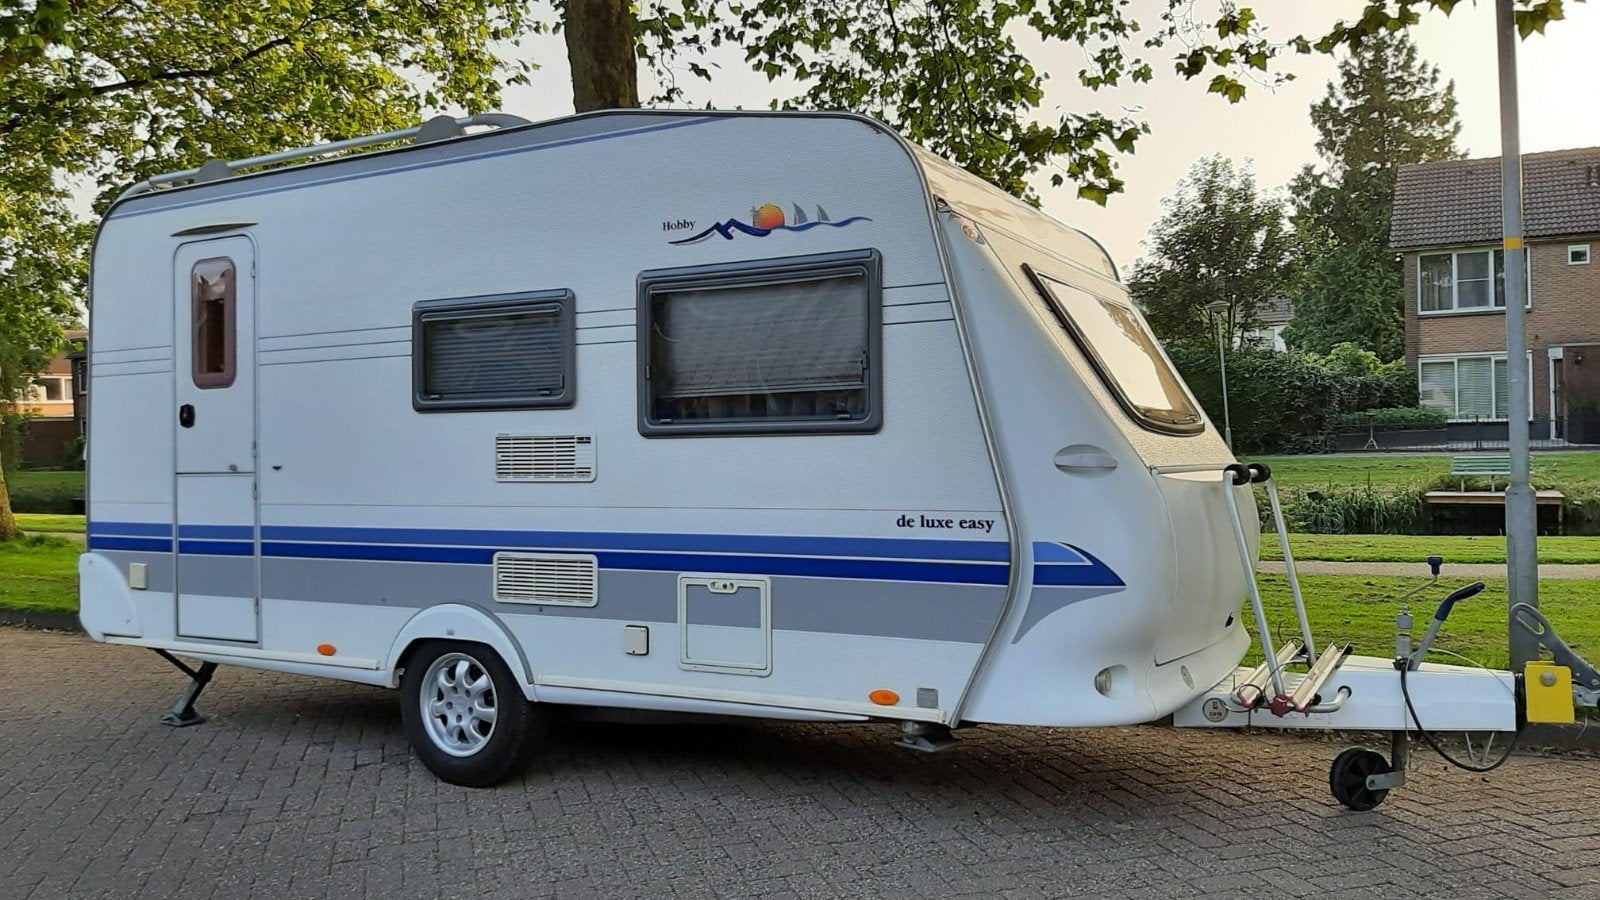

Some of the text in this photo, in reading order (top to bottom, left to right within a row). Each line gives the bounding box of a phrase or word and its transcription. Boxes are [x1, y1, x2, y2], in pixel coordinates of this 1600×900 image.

[662, 219, 696, 231] Hobby
[896, 514, 995, 533] de luxe easy
